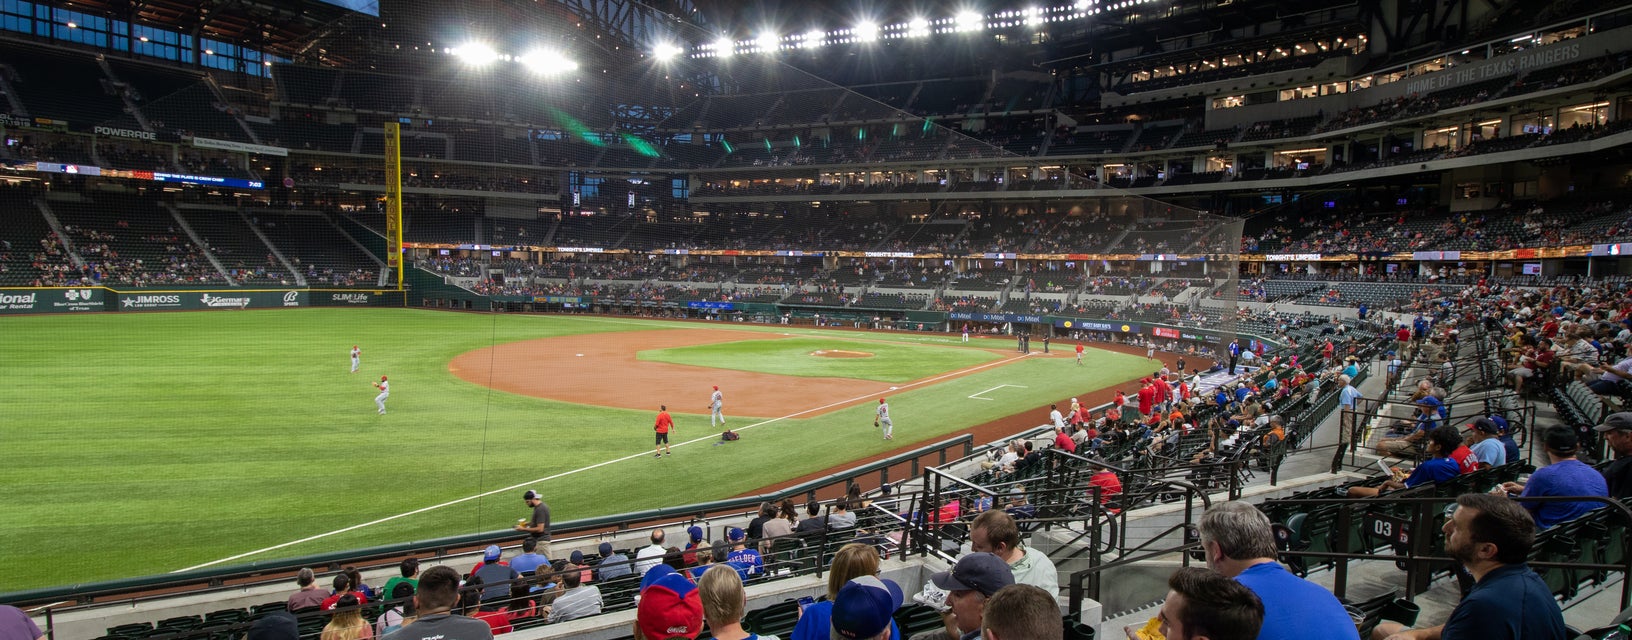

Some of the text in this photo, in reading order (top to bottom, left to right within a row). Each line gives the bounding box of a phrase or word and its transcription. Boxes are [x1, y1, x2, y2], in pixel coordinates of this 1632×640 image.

[1407, 43, 1581, 95] HOME OF THE TEXAS RANGERS
[94, 126, 157, 140] POWERADE
[1295, 253, 1321, 261] UMPIRES
[1374, 520, 1392, 537] 03
[666, 625, 688, 634] Coca-Cola
